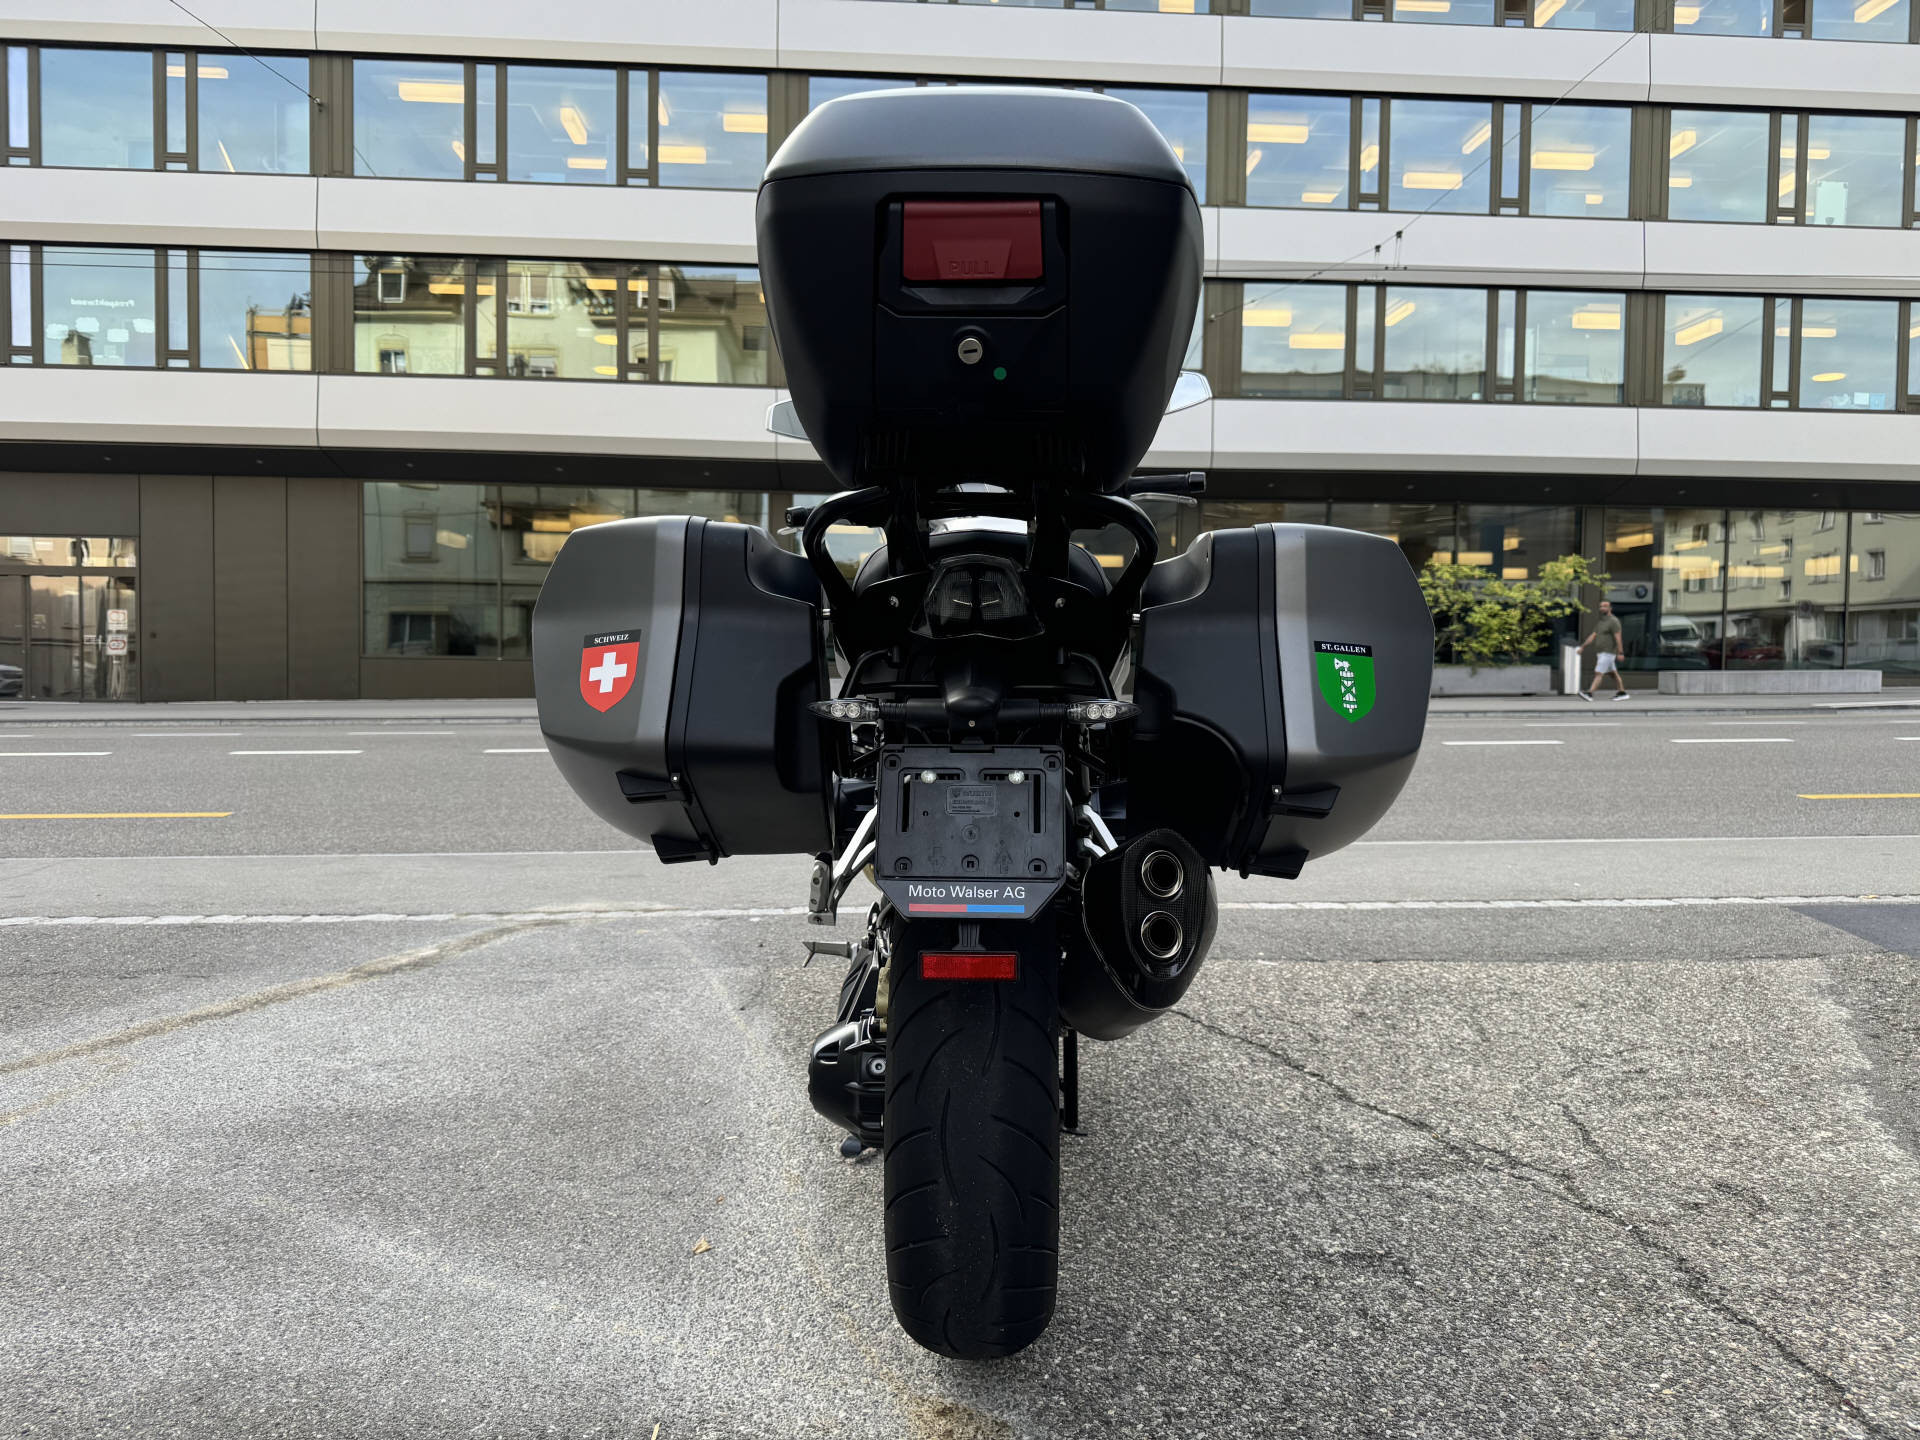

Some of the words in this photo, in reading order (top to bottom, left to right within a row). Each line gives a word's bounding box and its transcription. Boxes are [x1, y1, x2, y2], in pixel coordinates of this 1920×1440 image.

[947, 260, 995, 275] PULL
[594, 634, 629, 645] SCHWEIZ
[908, 884, 946, 898] Moto
[950, 885, 999, 898] Walser
[1002, 886, 1026, 899] AG
